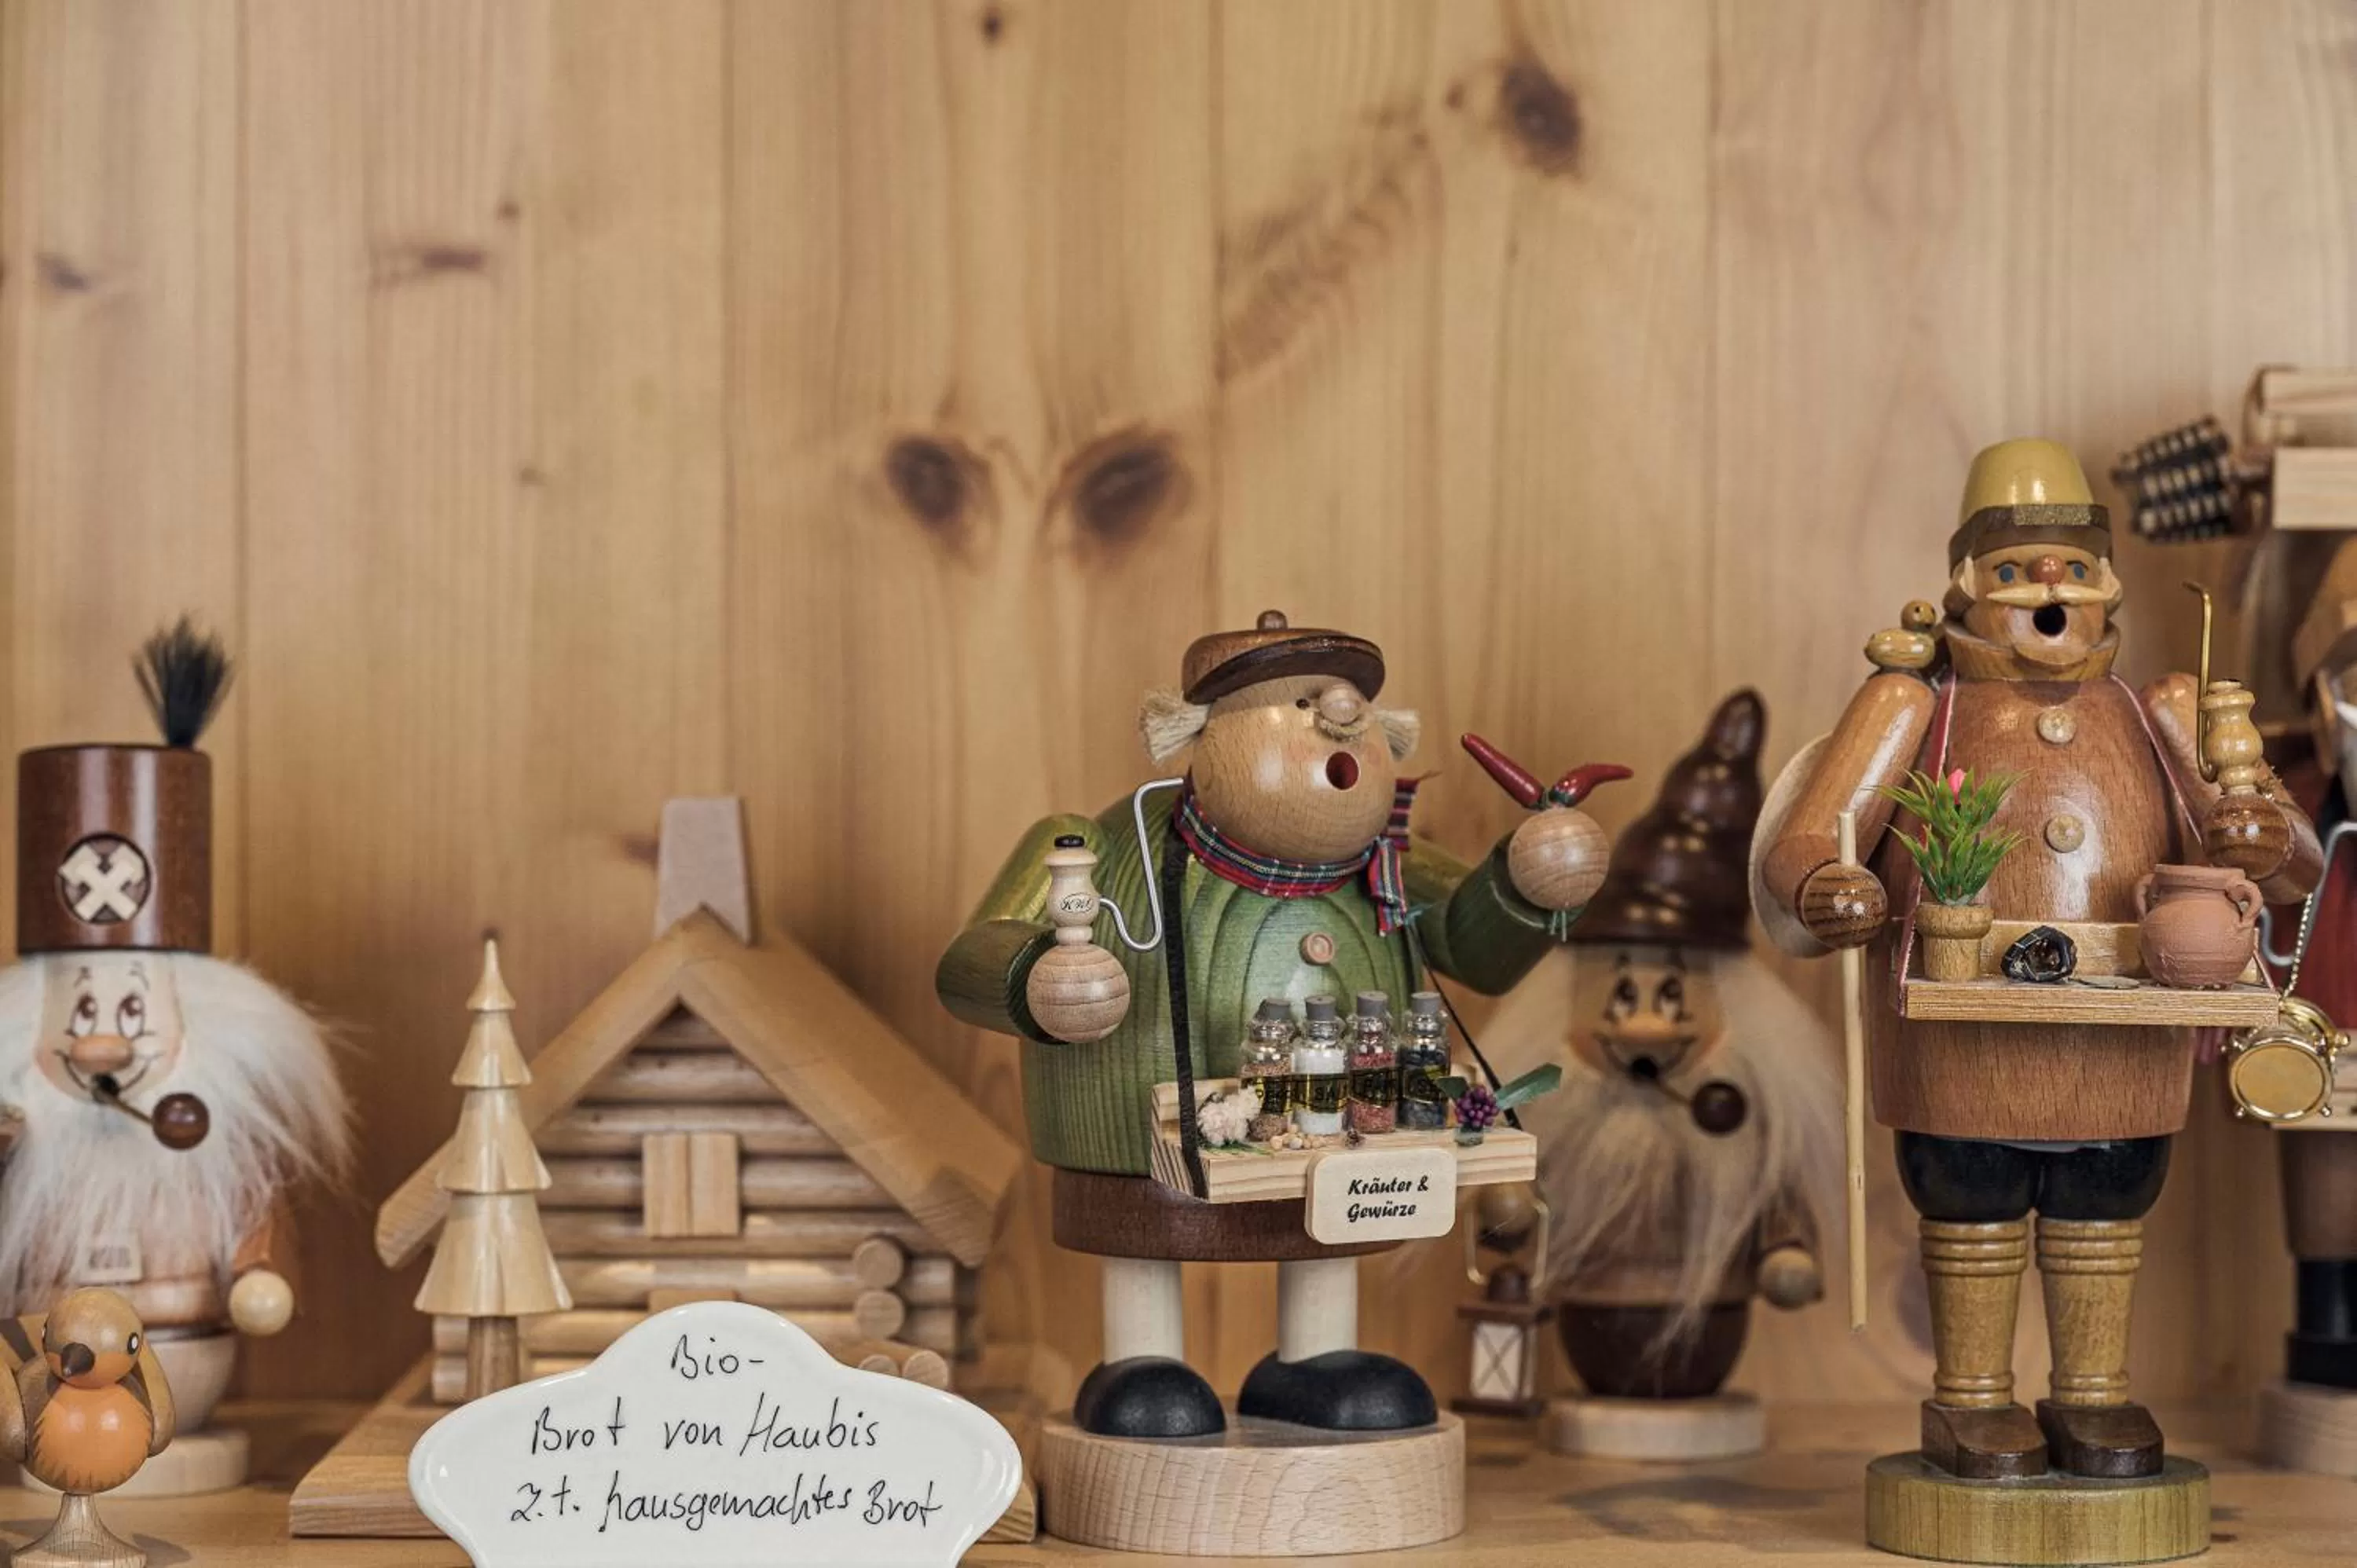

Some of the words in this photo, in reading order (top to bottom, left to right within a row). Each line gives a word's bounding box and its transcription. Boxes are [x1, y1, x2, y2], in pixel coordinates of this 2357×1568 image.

[1347, 1177, 1413, 1196] Kräuter
[1417, 1174, 1429, 1192] &
[1347, 1200, 1417, 1223] Gewürze
[670, 1334, 764, 1380] Bio-
[531, 1396, 626, 1456] Brot
[664, 1420, 723, 1450] von
[739, 1391, 880, 1457] Haubis
[598, 1470, 852, 1533] hausgemachtes
[863, 1479, 943, 1527] Brot
